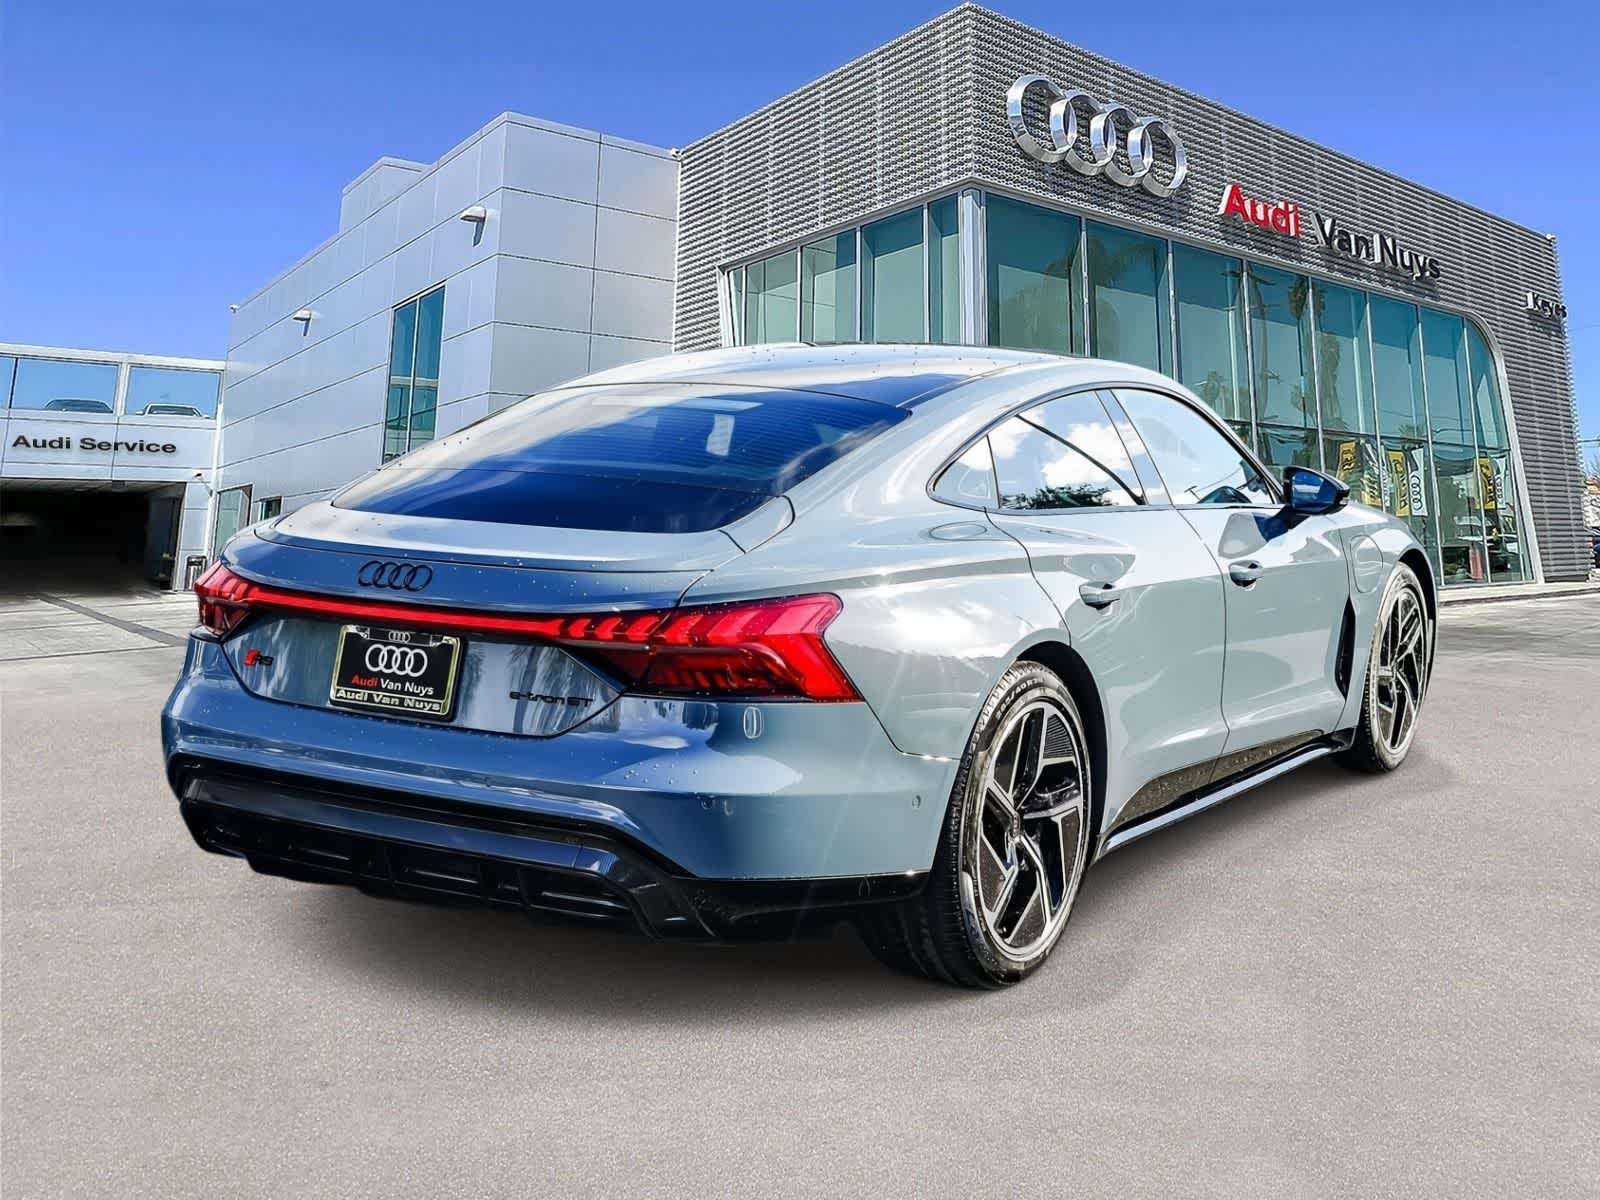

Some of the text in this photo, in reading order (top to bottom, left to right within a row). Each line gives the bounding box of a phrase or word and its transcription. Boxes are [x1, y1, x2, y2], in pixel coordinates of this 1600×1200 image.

[1218, 183, 1441, 281] Audi Van Nuys
[12, 434, 177, 454] Audi Service
[351, 674, 434, 696] Audi Van Nuys
[336, 689, 441, 711] Audi Van Nuys
